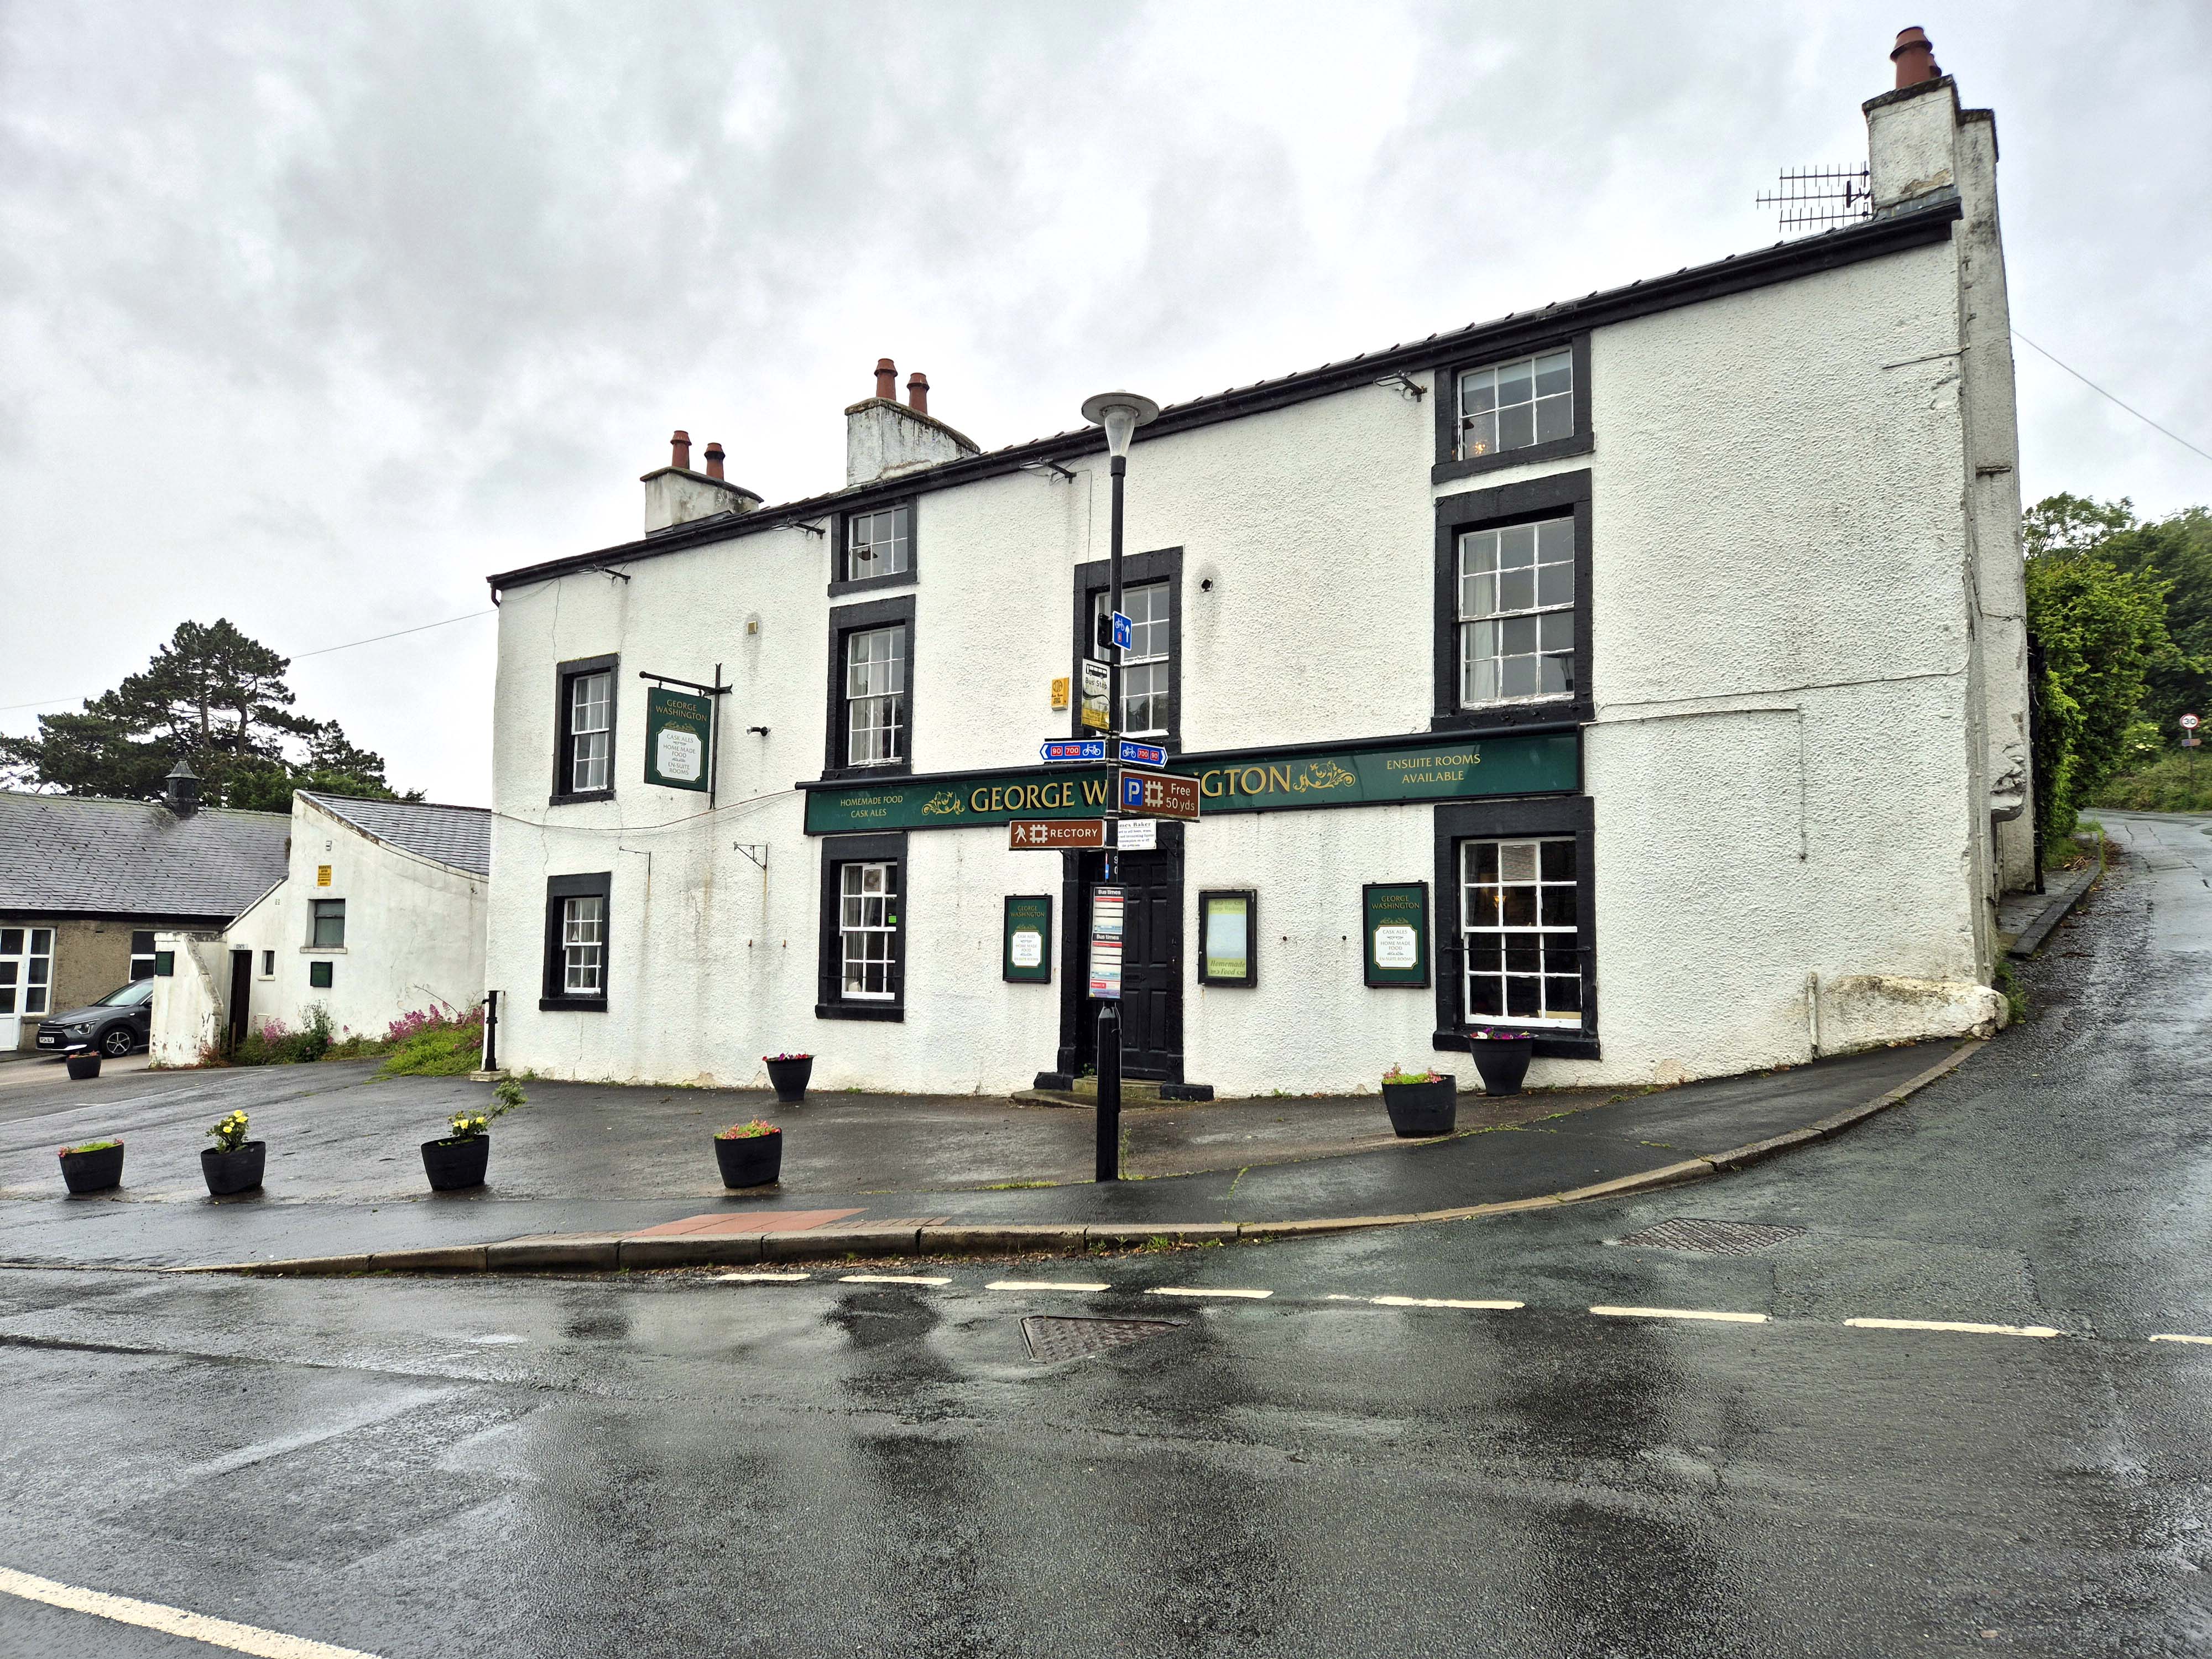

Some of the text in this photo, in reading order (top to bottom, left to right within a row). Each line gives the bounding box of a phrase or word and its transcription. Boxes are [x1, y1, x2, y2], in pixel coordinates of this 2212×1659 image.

[1097, 680, 1108, 690] Stop
[666, 699, 697, 712] GEORGE
[655, 705, 707, 722] WASHINGTON
[668, 761, 690, 770] EN-SUITE
[1387, 754, 1481, 770] ENSUITE ROOMS
[1402, 770, 1464, 784] AVAILABLE
[971, 782, 1075, 812] GEORGE
[1128, 781, 1191, 802] P Free
[841, 796, 881, 806] HOMEMADE
[1166, 797, 1195, 811] 50 yds
[851, 808, 887, 818] CASK ALES
[1051, 829, 1097, 837] RECTORY
